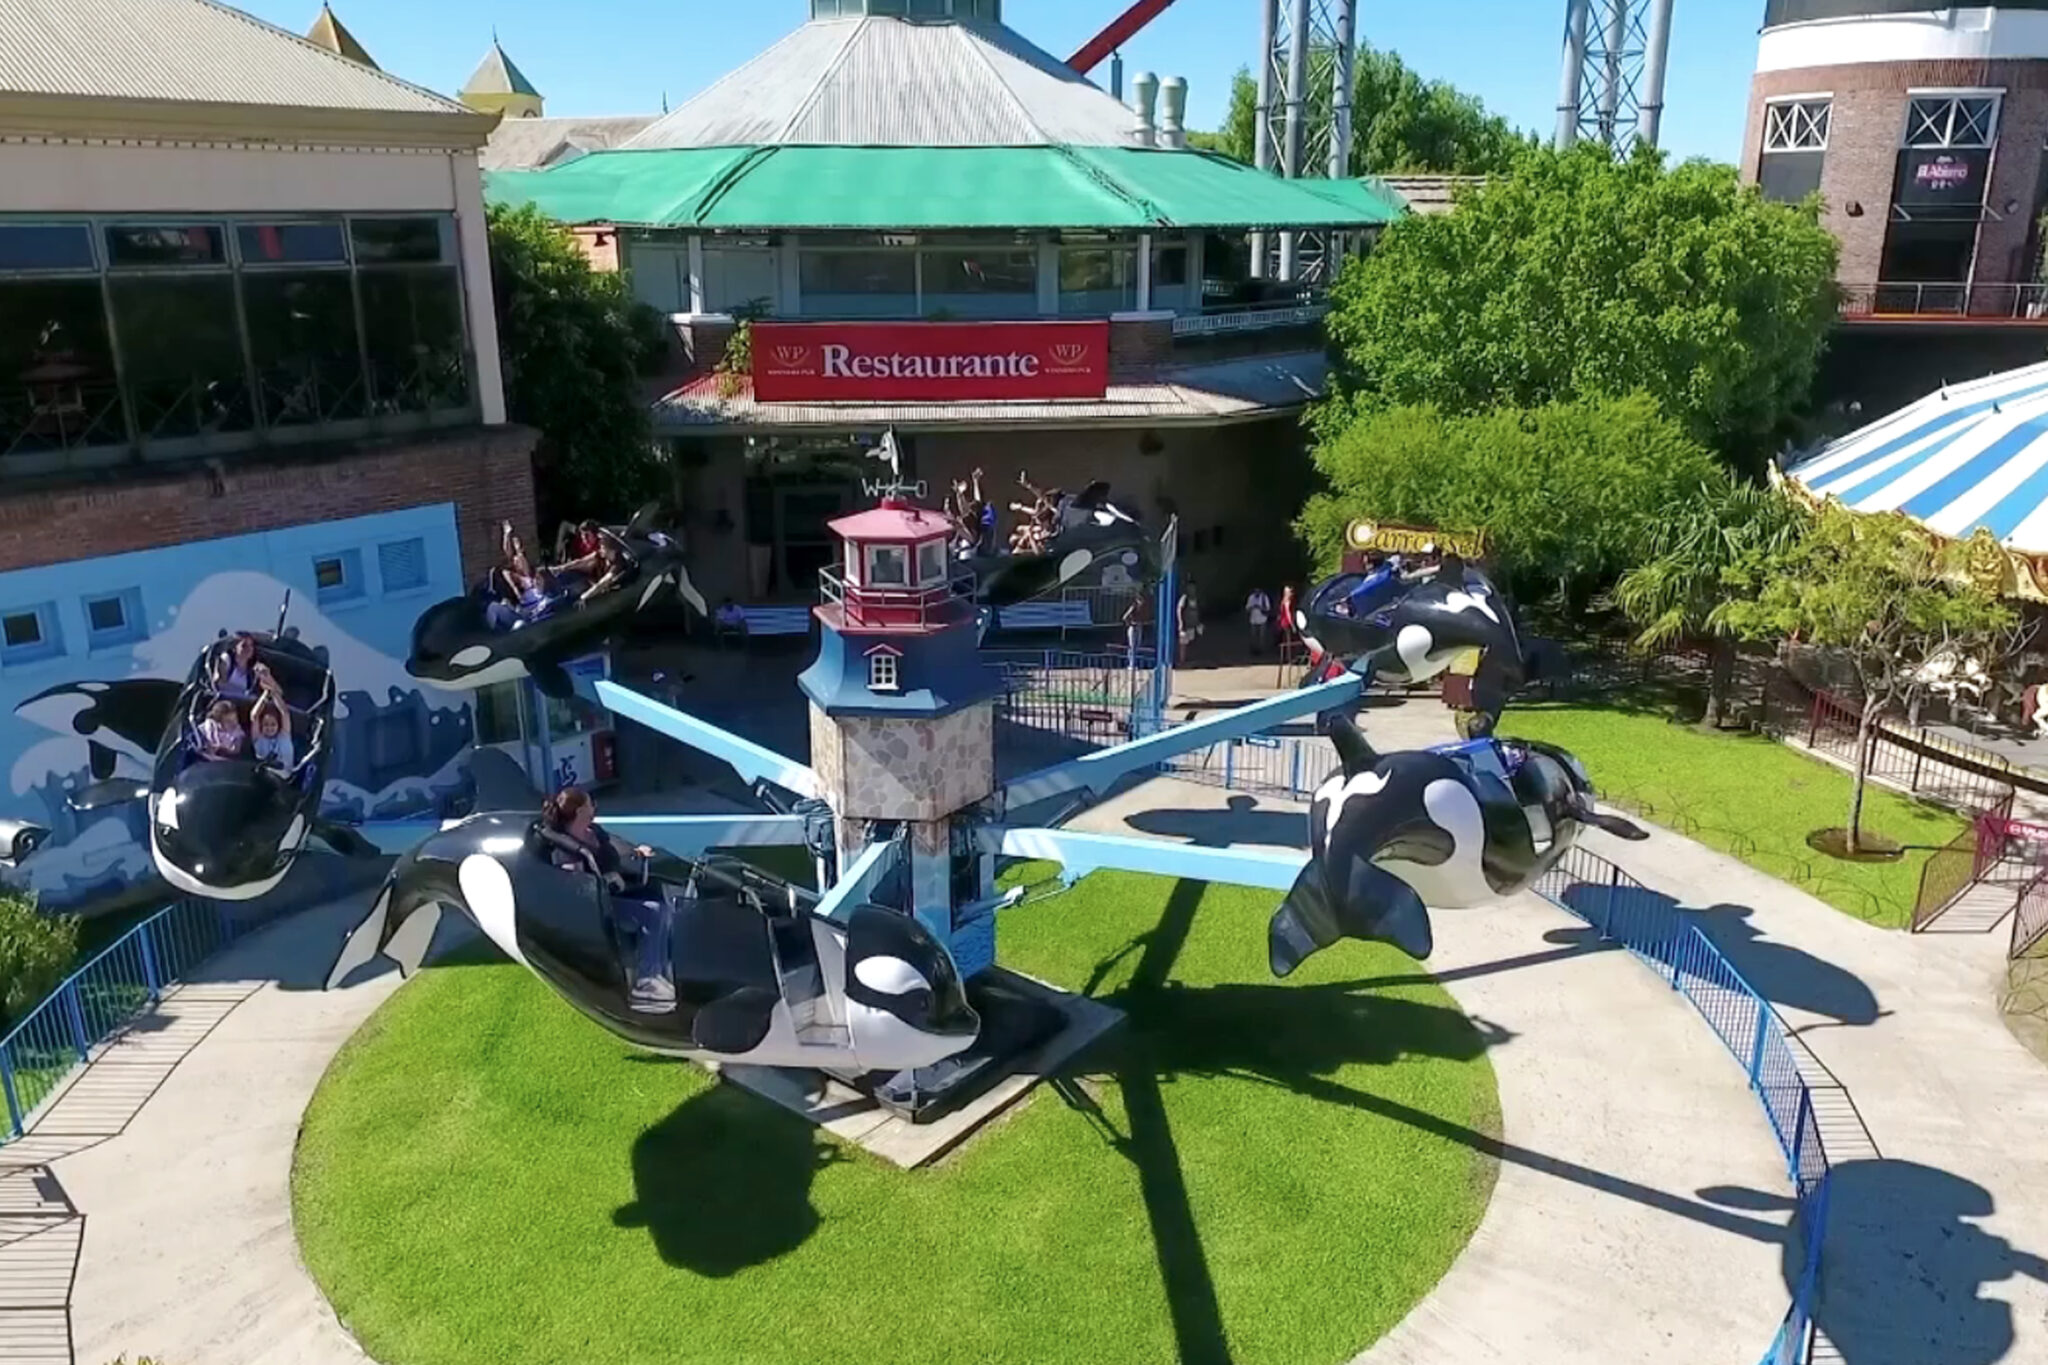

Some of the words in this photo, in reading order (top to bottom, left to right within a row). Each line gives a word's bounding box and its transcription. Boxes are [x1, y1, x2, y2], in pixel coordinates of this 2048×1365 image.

[776, 345, 805, 360] WP
[1055, 344, 1082, 358] WP
[821, 344, 1039, 378] Restaurante
